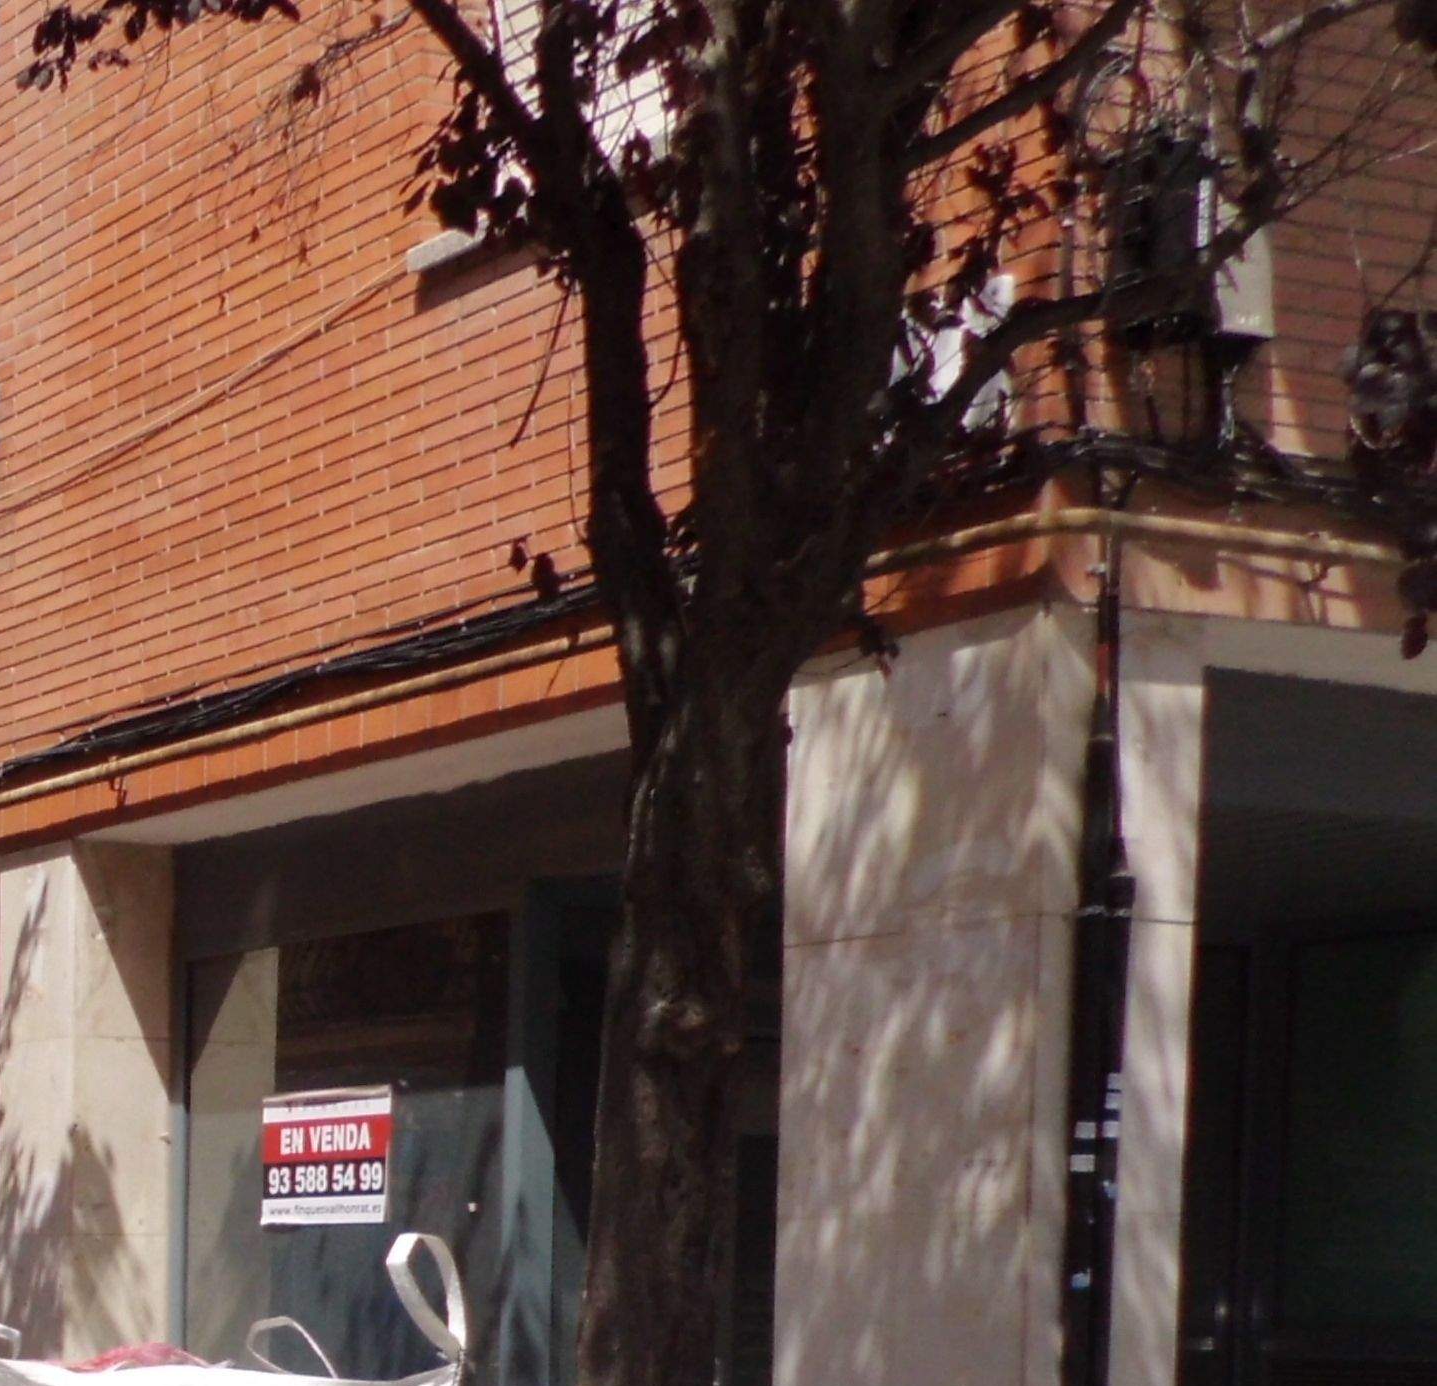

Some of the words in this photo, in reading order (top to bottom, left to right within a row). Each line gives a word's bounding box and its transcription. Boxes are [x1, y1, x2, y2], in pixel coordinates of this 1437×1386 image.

[281, 1127, 303, 1155] EN
[309, 1122, 370, 1153] VENDA
[268, 1167, 290, 1194] 93
[295, 1165, 328, 1193] 588
[332, 1163, 355, 1191] 54
[359, 1161, 382, 1190] 99
